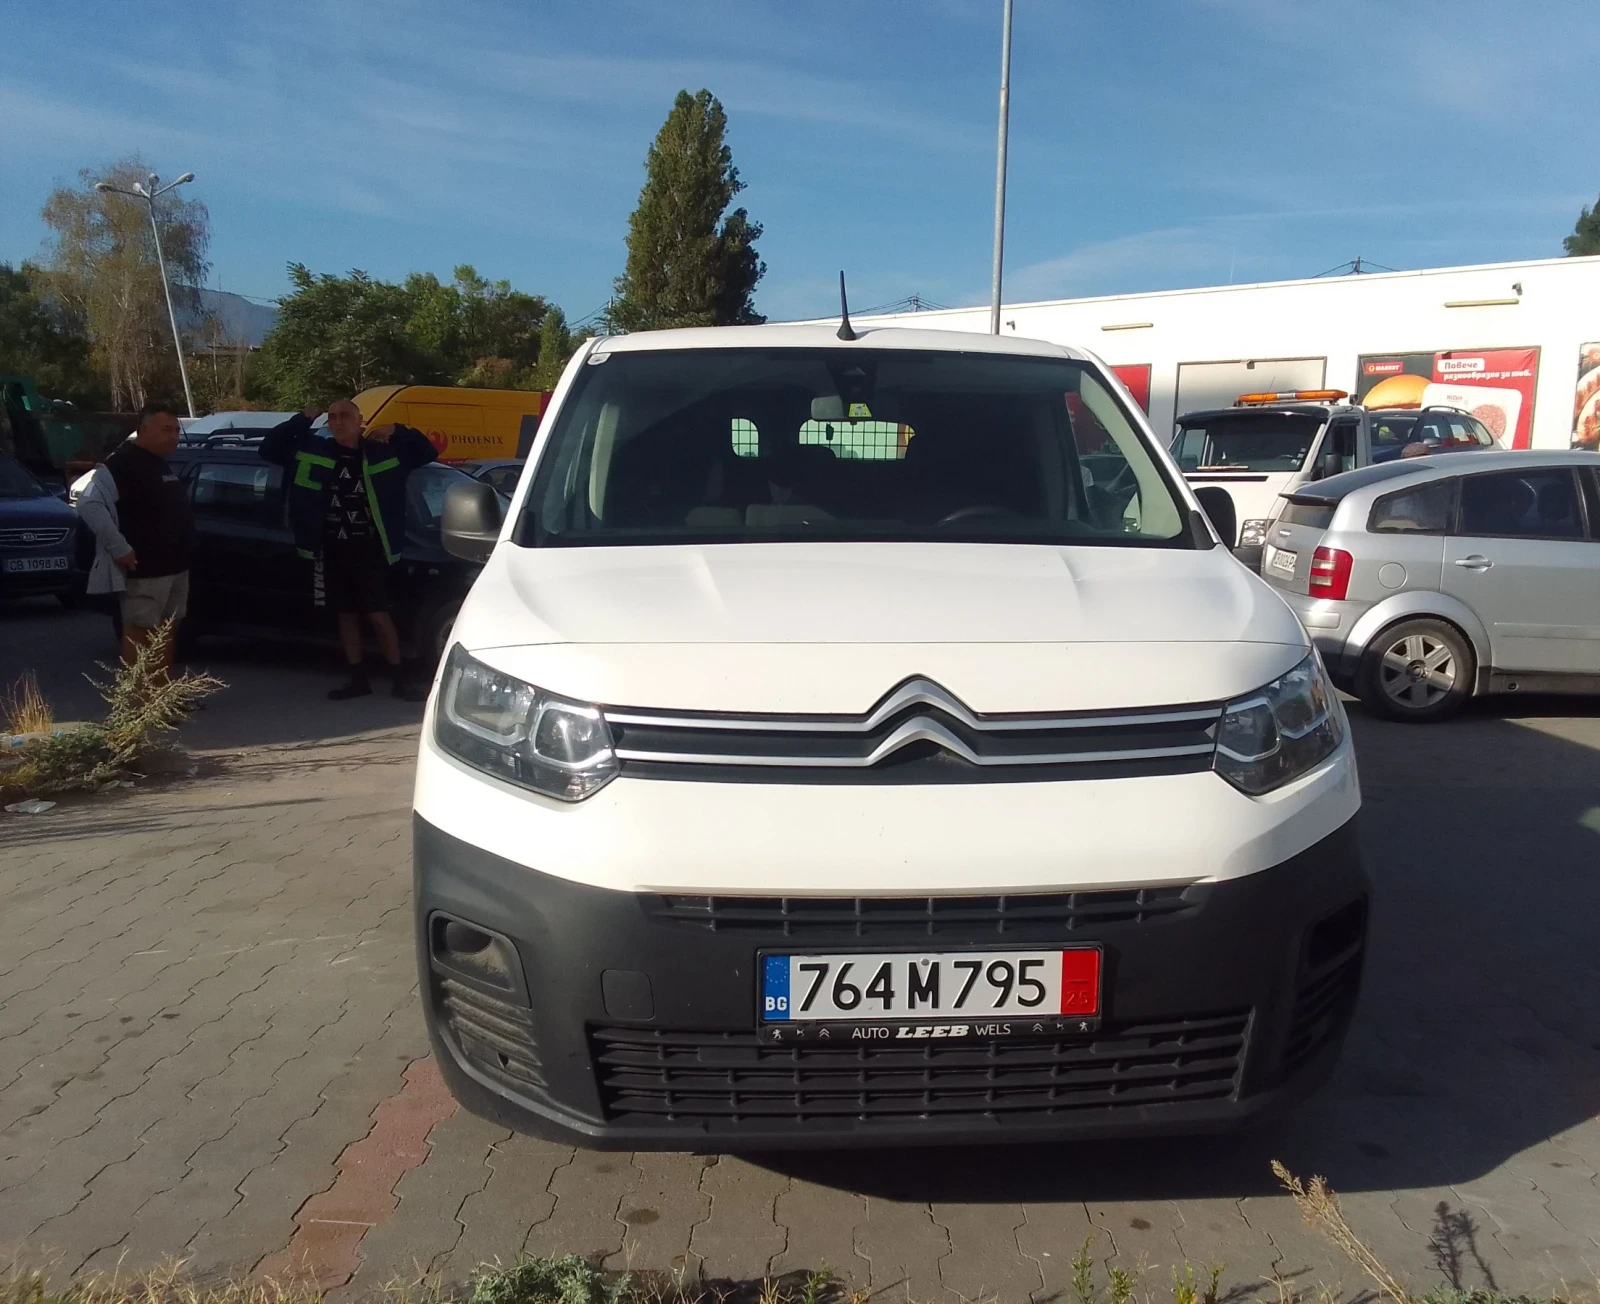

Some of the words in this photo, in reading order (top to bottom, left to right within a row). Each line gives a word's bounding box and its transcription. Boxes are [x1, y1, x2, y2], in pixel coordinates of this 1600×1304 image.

[1444, 361, 1478, 370] Повече
[451, 434, 504, 445] PHOENIX
[798, 961, 895, 1012] 764
[907, 961, 940, 1010] M
[952, 959, 1046, 1009] 795
[765, 996, 788, 1011] BG
[851, 1027, 890, 1039] AUTO
[895, 1024, 970, 1039] LEEB
[974, 1023, 1011, 1036] WELS
